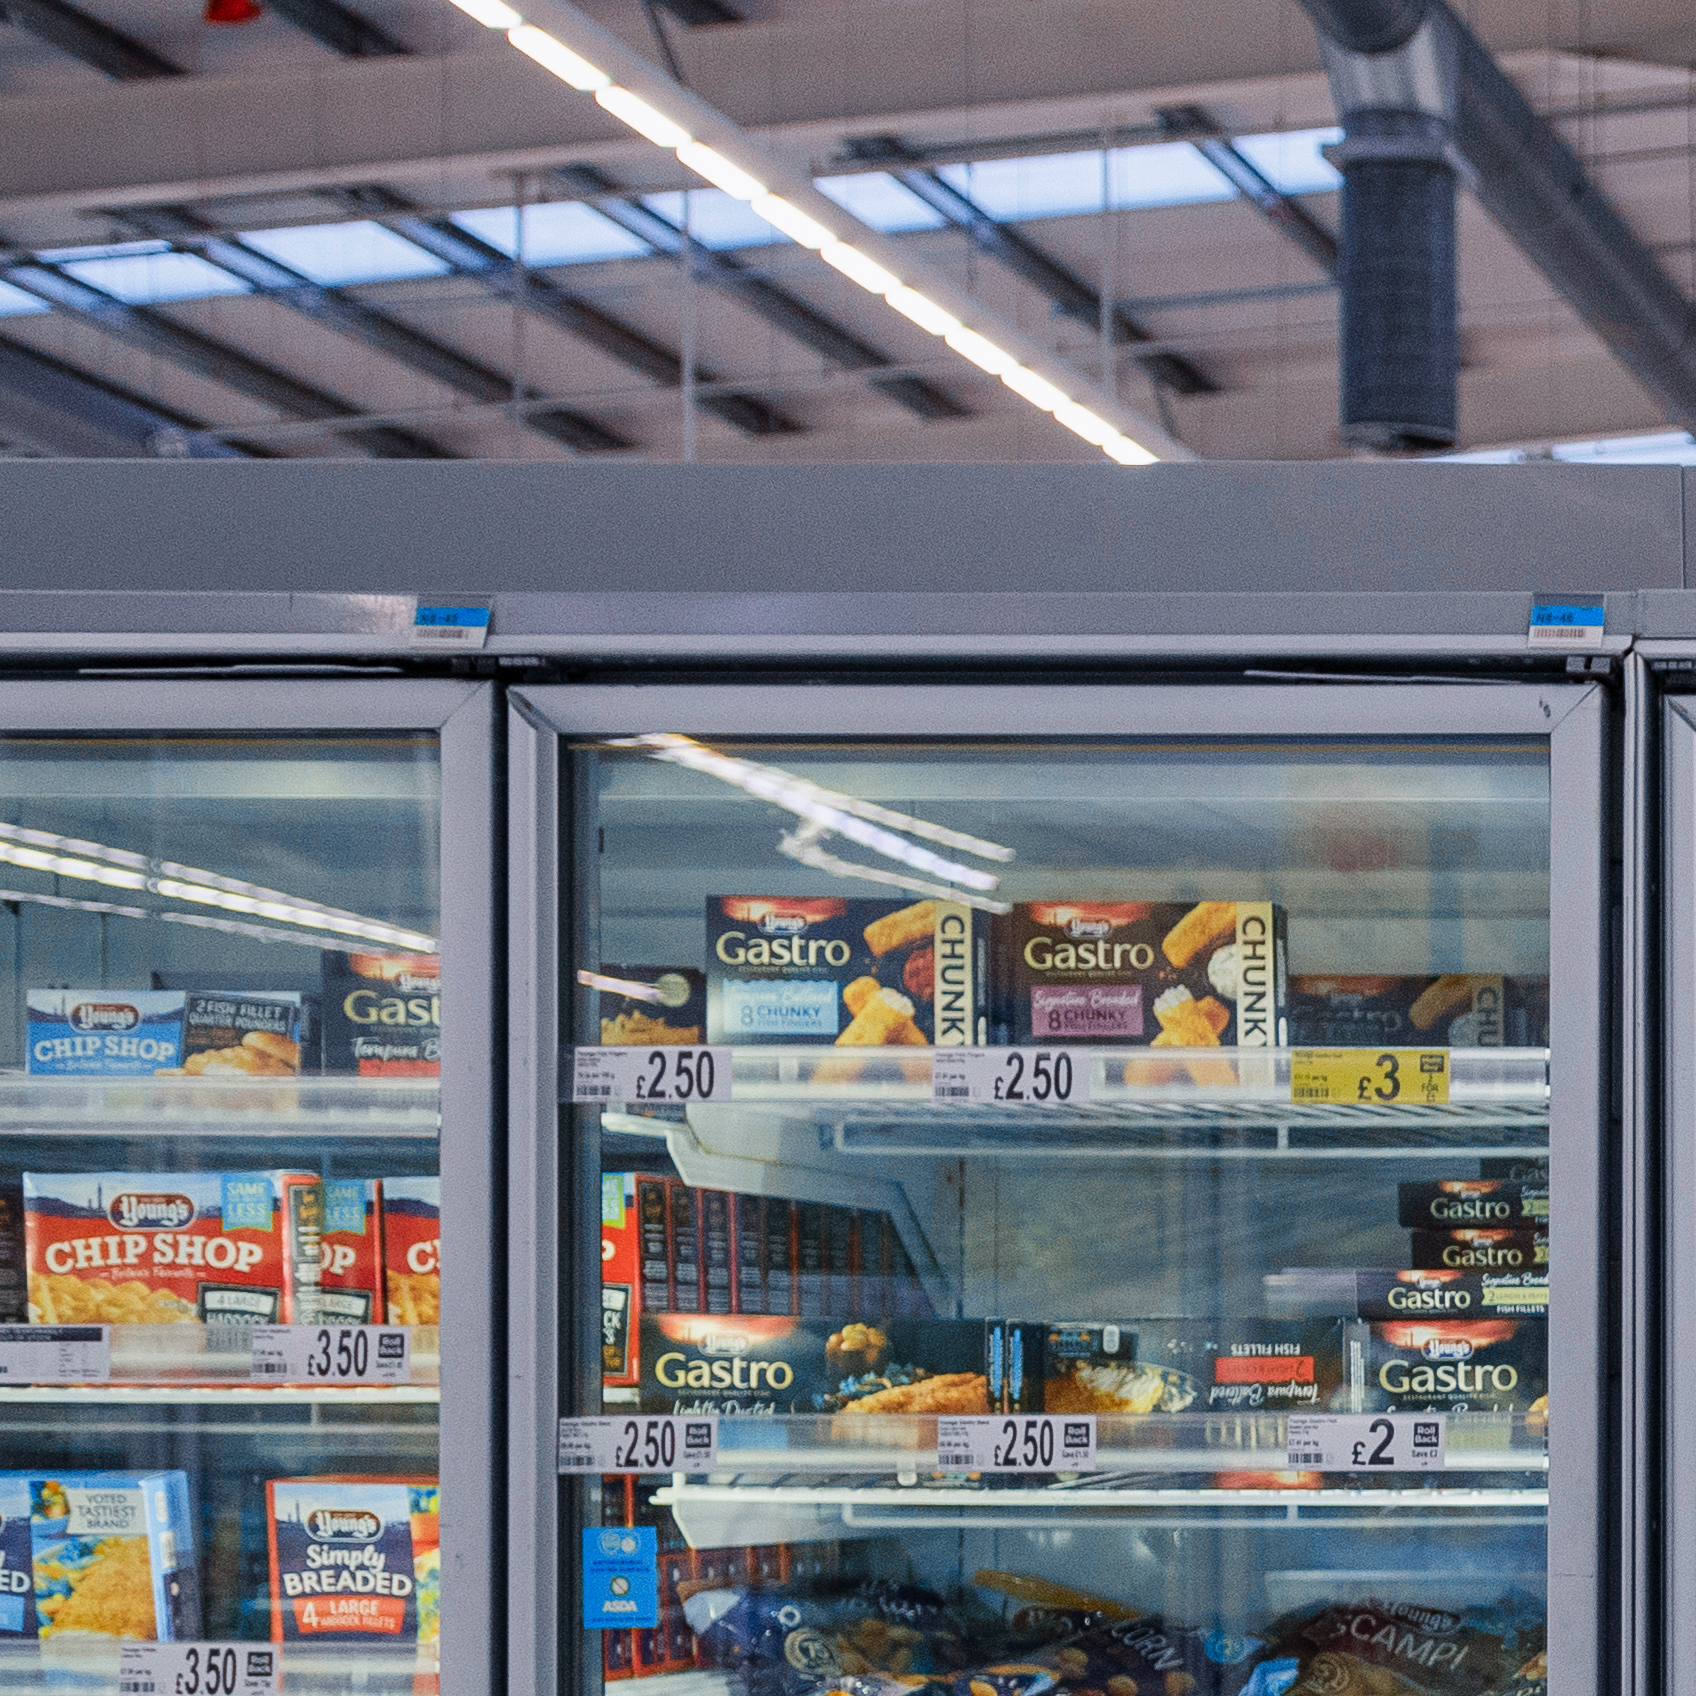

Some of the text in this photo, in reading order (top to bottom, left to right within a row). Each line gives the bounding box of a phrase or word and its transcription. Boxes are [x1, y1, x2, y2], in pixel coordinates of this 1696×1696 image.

[715, 931, 851, 968] Gastro
[1024, 937, 1156, 971] Gastro
[240, 1005, 283, 1020] FILLET
[756, 1005, 820, 1020] CHUNKY
[1048, 1008, 1127, 1031] 8 CHUNKY
[34, 1038, 176, 1062] CHIP SHOP
[636, 1051, 716, 1101] £2.50
[994, 1051, 1074, 1101] £2.50
[1357, 1054, 1401, 1101] £3
[1430, 1199, 1511, 1220] Gastro
[46, 1233, 264, 1275] CHIP SHOP
[1442, 1245, 1523, 1267] Gastro
[1388, 1288, 1471, 1312] Gastro
[308, 1330, 369, 1377] £3.50
[1230, 1343, 1274, 1357] FILLETS
[655, 1352, 796, 1391] Gastro
[1378, 1360, 1519, 1396] Gastro
[1065, 1435, 1089, 1446] Back
[1066, 1424, 1089, 1434] Roll
[1352, 1418, 1395, 1466] £2
[1415, 1424, 1439, 1434] Roll
[1415, 1435, 1439, 1446] Back
[616, 1420, 675, 1468] £2.50
[994, 1419, 1055, 1467] £2.50
[76, 1506, 137, 1519] TASTIEST
[85, 1494, 128, 1506] VOTED
[305, 1545, 386, 1572] Simply
[283, 1571, 413, 1596] BREADED
[302, 1600, 380, 1628] 4 LARGE
[176, 1648, 237, 1695] £3.50
